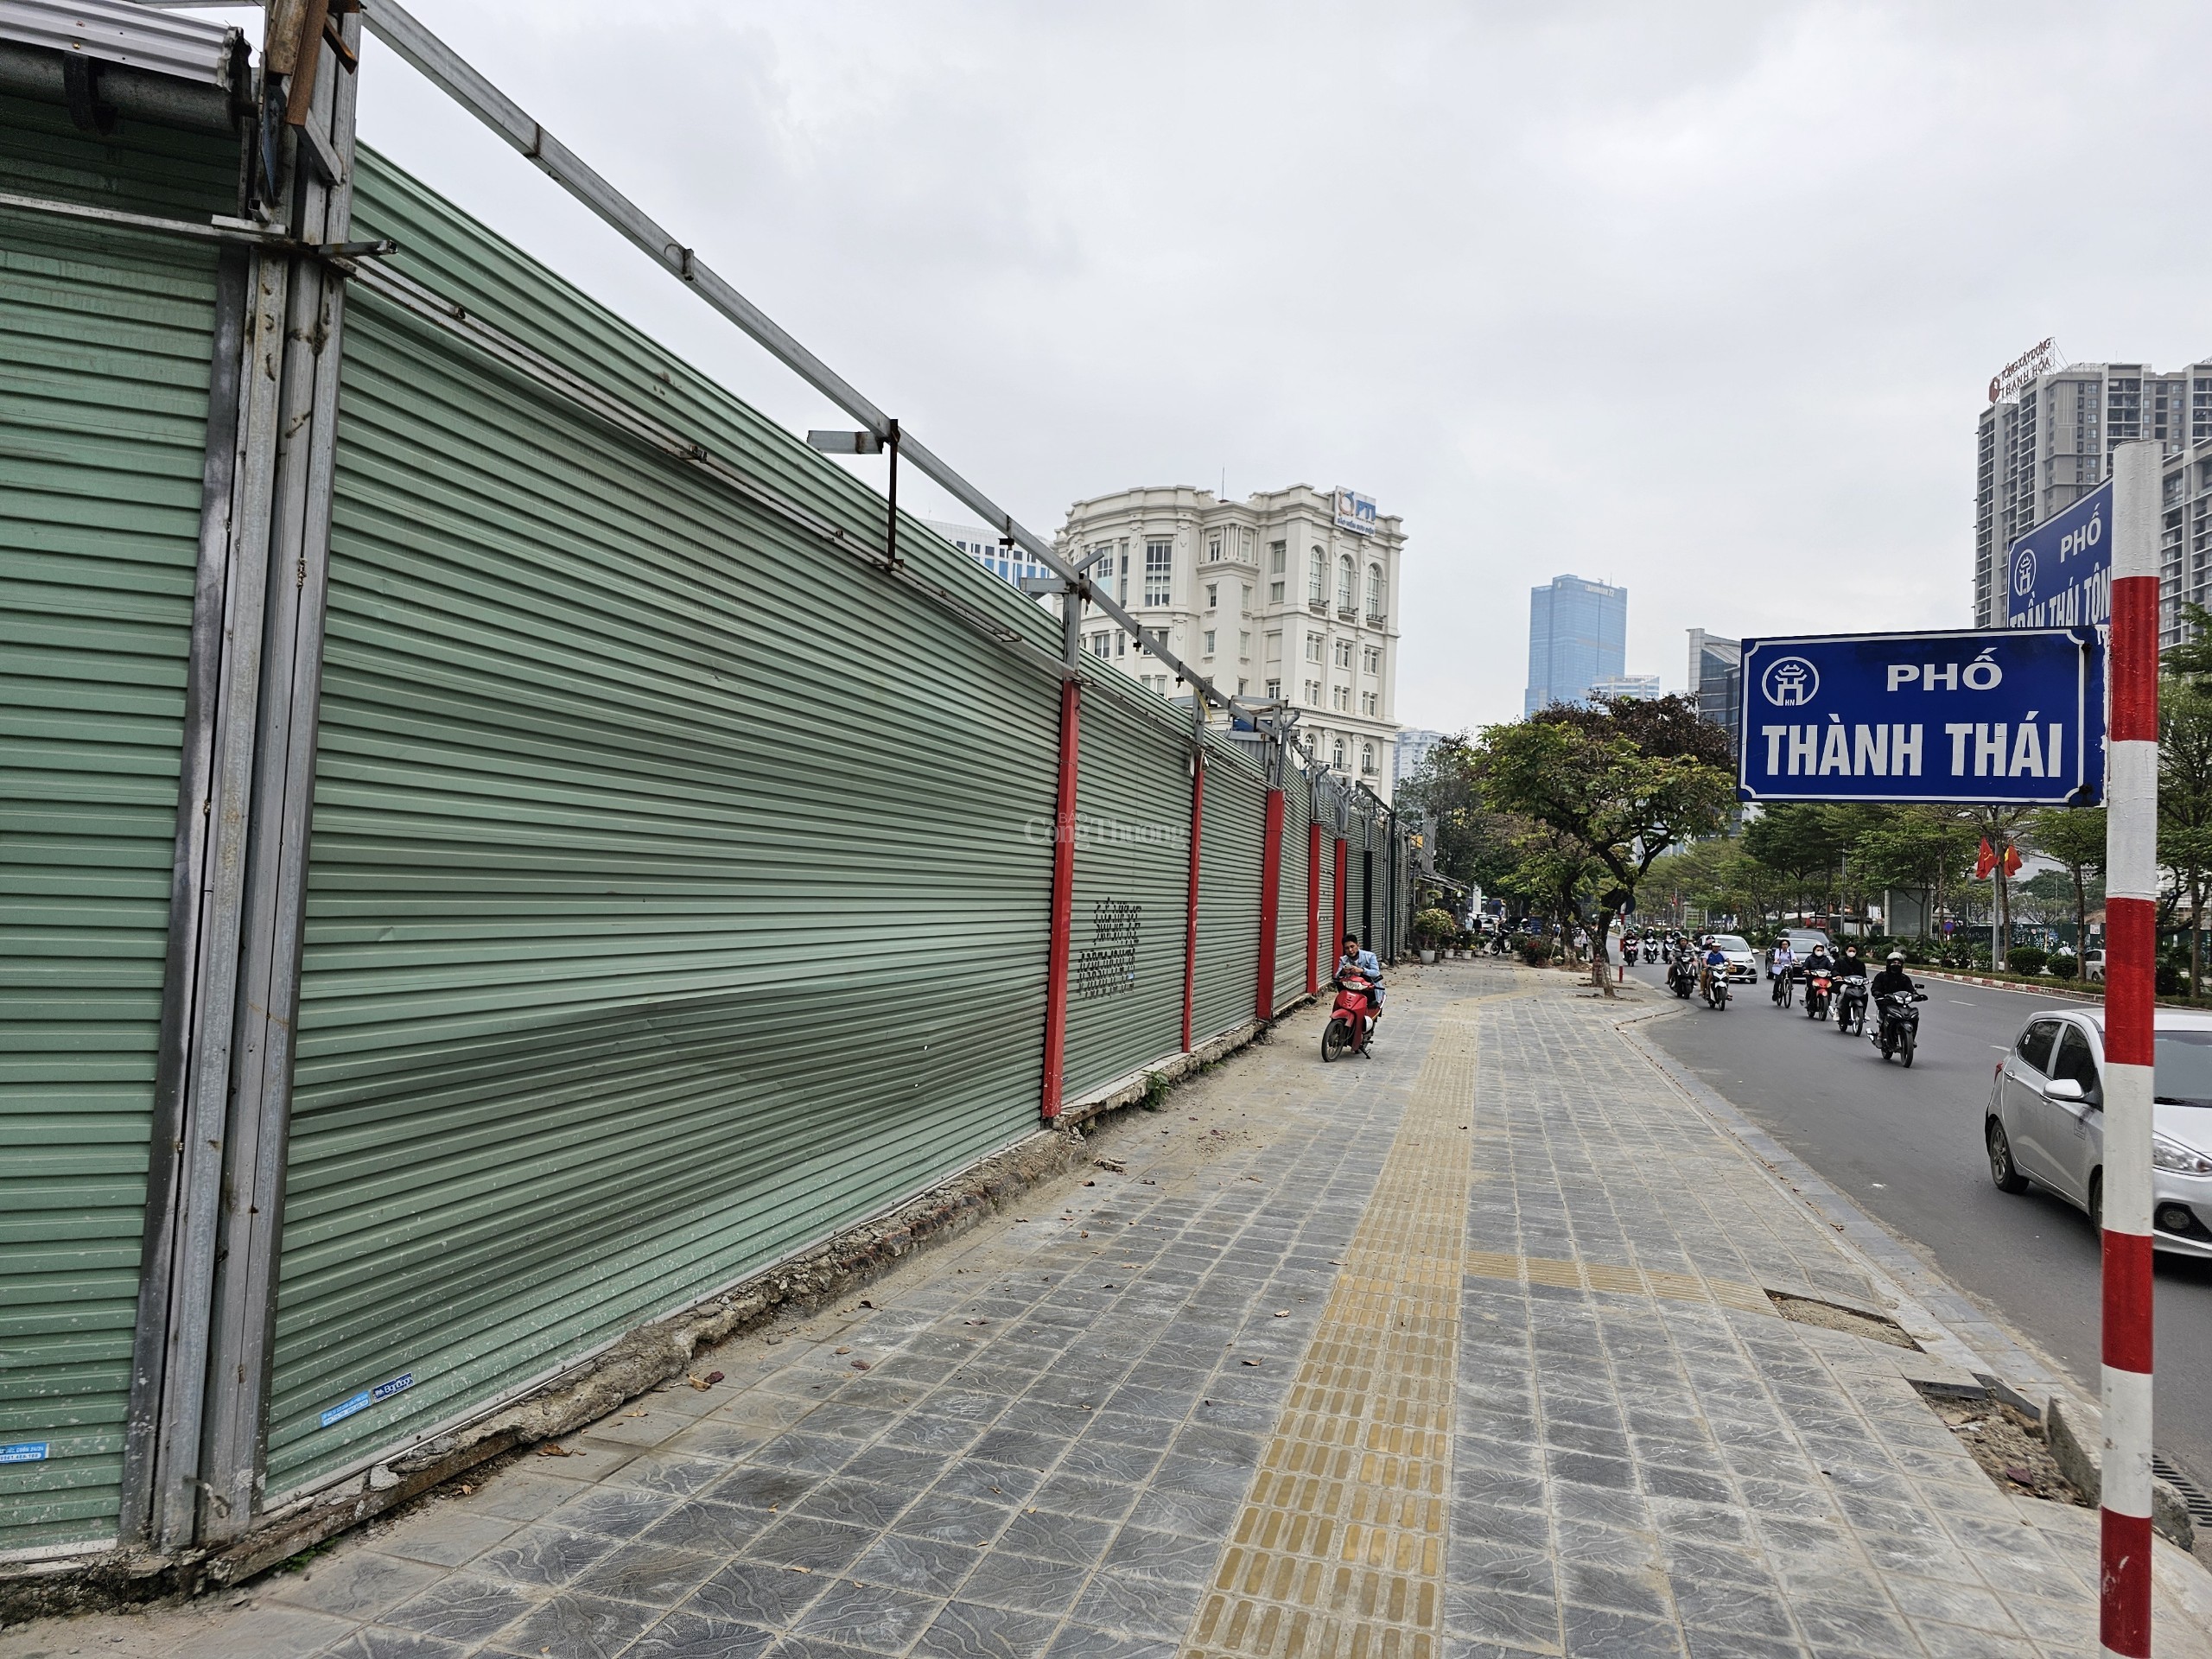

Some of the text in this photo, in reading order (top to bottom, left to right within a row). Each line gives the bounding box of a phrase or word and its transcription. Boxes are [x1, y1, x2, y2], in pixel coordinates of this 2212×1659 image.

[1356, 499, 1376, 521] PTI
[2060, 503, 2102, 563] PHỐ
[2010, 562, 2111, 627] ẦN THÁI TÔN
[1887, 647, 2003, 692] PHỐ
[1762, 710, 2063, 778] THÀNH THÁI
